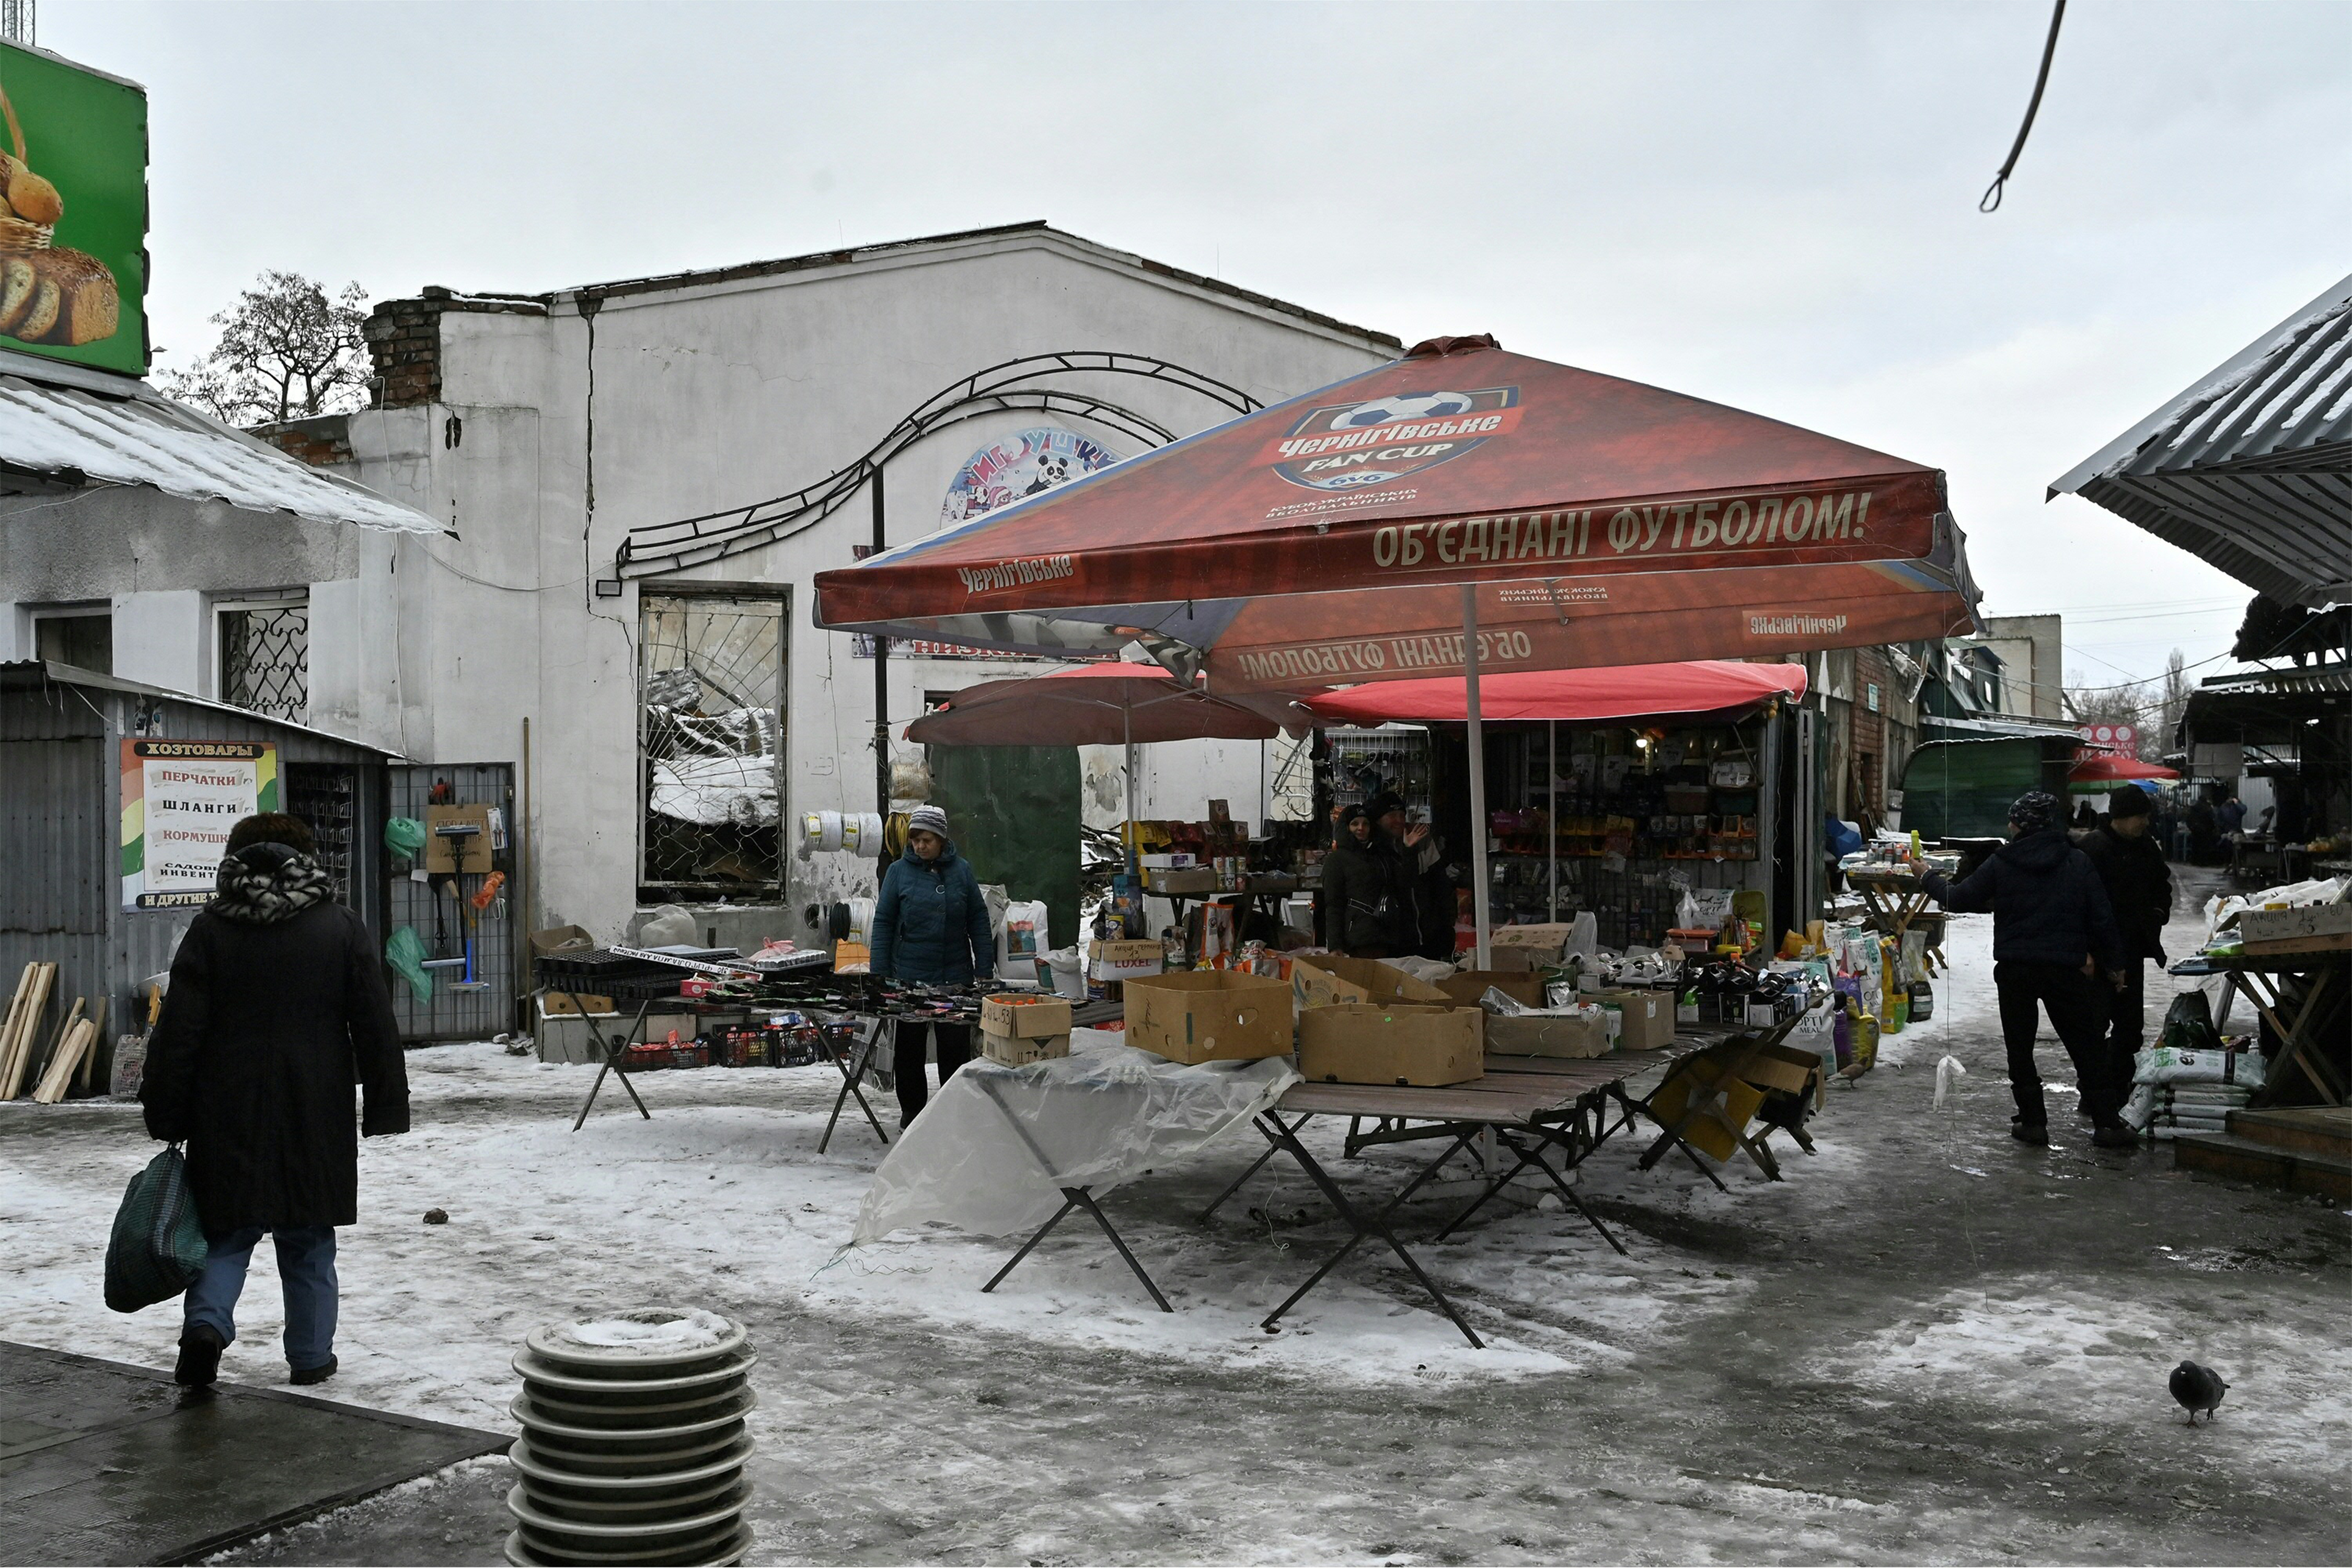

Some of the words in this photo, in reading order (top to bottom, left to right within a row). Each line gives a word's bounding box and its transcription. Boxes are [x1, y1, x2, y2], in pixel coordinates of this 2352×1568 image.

[1278, 415, 1503, 458] Чернігівське
[1301, 451, 1374, 472] FAN
[1376, 443, 1454, 460] CUP
[1265, 494, 1416, 518] ВБОЛІВАЛЬНИКІВ
[1271, 500, 1321, 512] КУБОК
[1318, 488, 1420, 505] УКРАЇНСЬКИХ
[1373, 511, 1592, 567] ОБ'ЄДНАНІ
[1608, 492, 1872, 553] ФУТБОЛОМ!
[956, 555, 1074, 594] Чернігівське
[147, 743, 253, 756] ХОЗТОВАРЫ
[163, 771, 235, 786] ПЕРЧАТКИ
[163, 800, 237, 813] ШЛАНГИ
[160, 869, 214, 878] ИНВЕНТ
[145, 895, 155, 906] И
[157, 893, 207, 907] ДРУГИЕ
[210, 893, 220, 904] Т
[1129, 950, 1140, 959] 13
[1115, 960, 1151, 968] LUXEL
